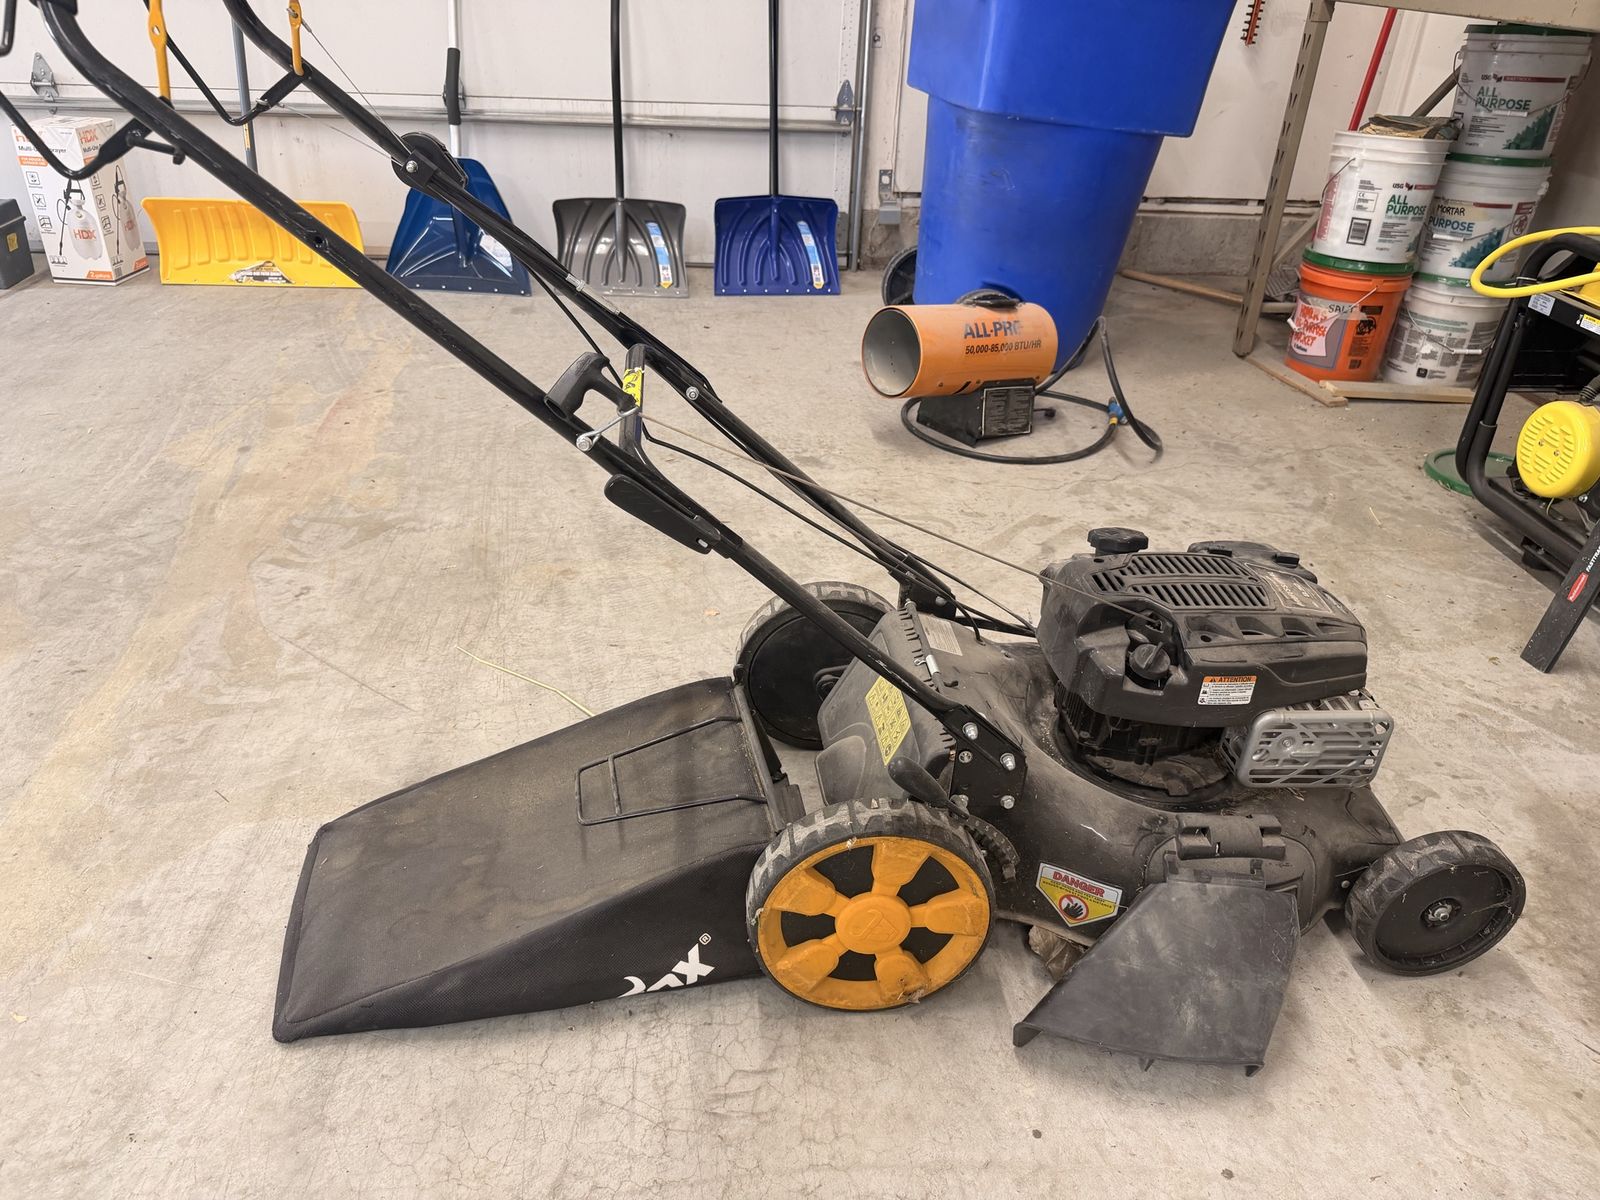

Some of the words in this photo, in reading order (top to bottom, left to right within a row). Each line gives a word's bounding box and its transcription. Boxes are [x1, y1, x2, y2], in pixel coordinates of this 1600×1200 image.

[1477, 86, 1498, 97] ALL
[1475, 97, 1532, 111] PURPOSE
[1388, 194, 1409, 205] ALL
[1385, 204, 1427, 216] PURPOSE
[1437, 204, 1466, 217] MORTAR
[1428, 215, 1475, 233] PURPOSE
[74, 229, 96, 240] HDX
[1328, 303, 1355, 314] SALT
[965, 343, 1013, 355] 50,000-85,000
[1014, 339, 1042, 351] BTU/HR
[1053, 871, 1104, 897] DANGER
